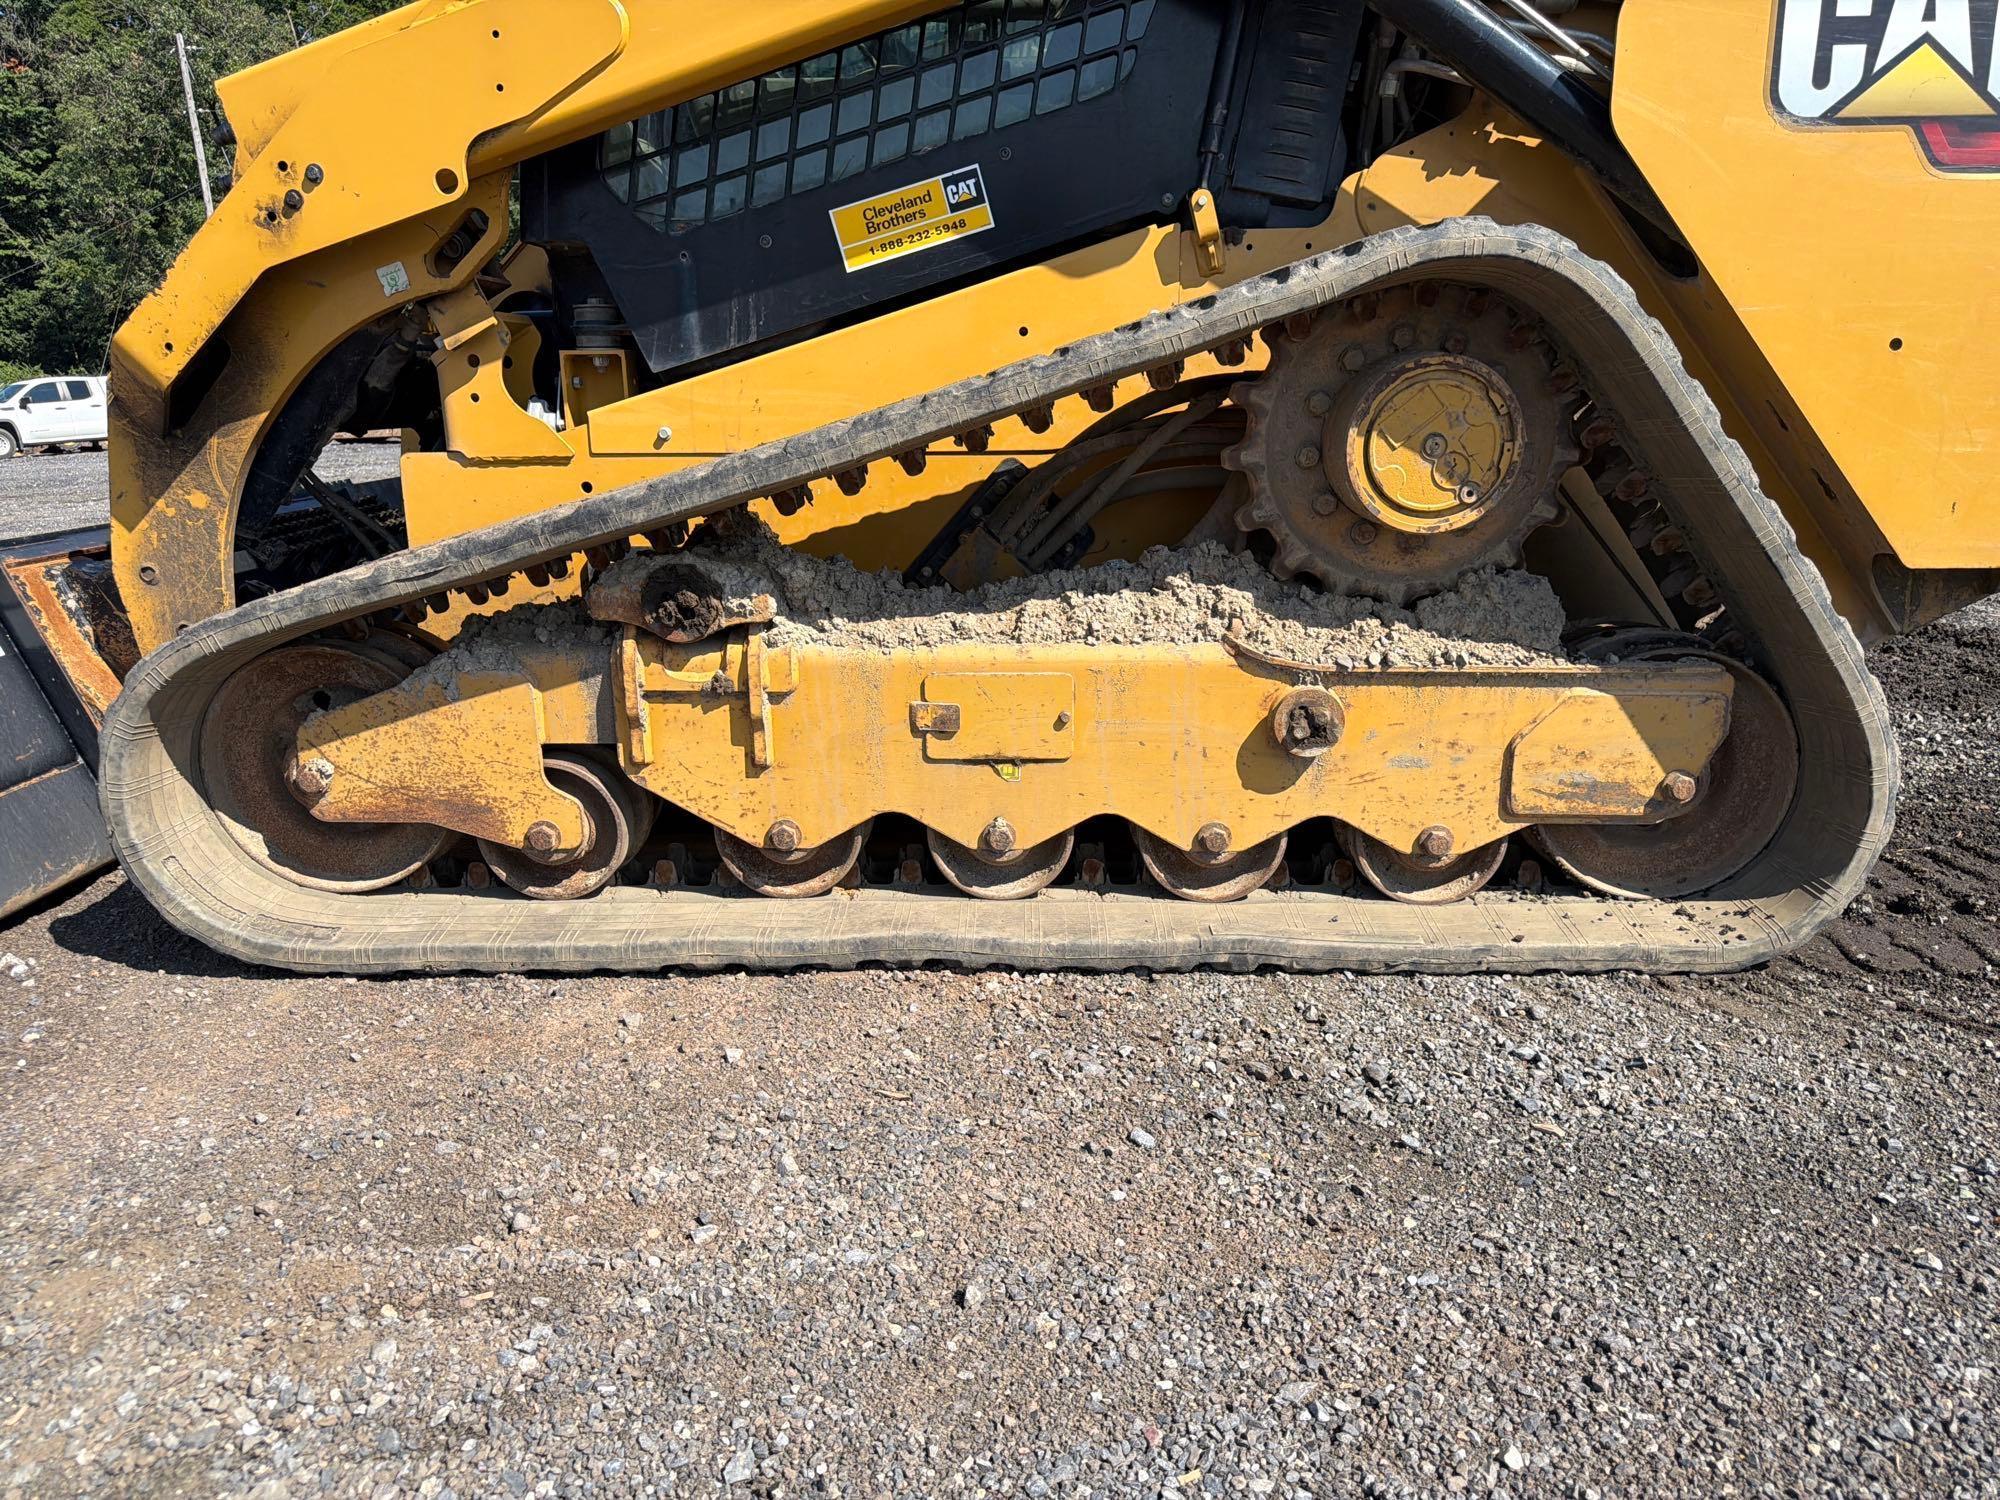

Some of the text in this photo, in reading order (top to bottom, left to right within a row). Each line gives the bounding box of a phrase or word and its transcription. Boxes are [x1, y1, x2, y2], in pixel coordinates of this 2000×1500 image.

[1778, 0, 2000, 118] CA
[862, 190, 932, 221] Cleveland
[946, 178, 977, 204] CAT
[865, 208, 926, 235] Brothers
[869, 218, 967, 255] 1-888-232-5948
